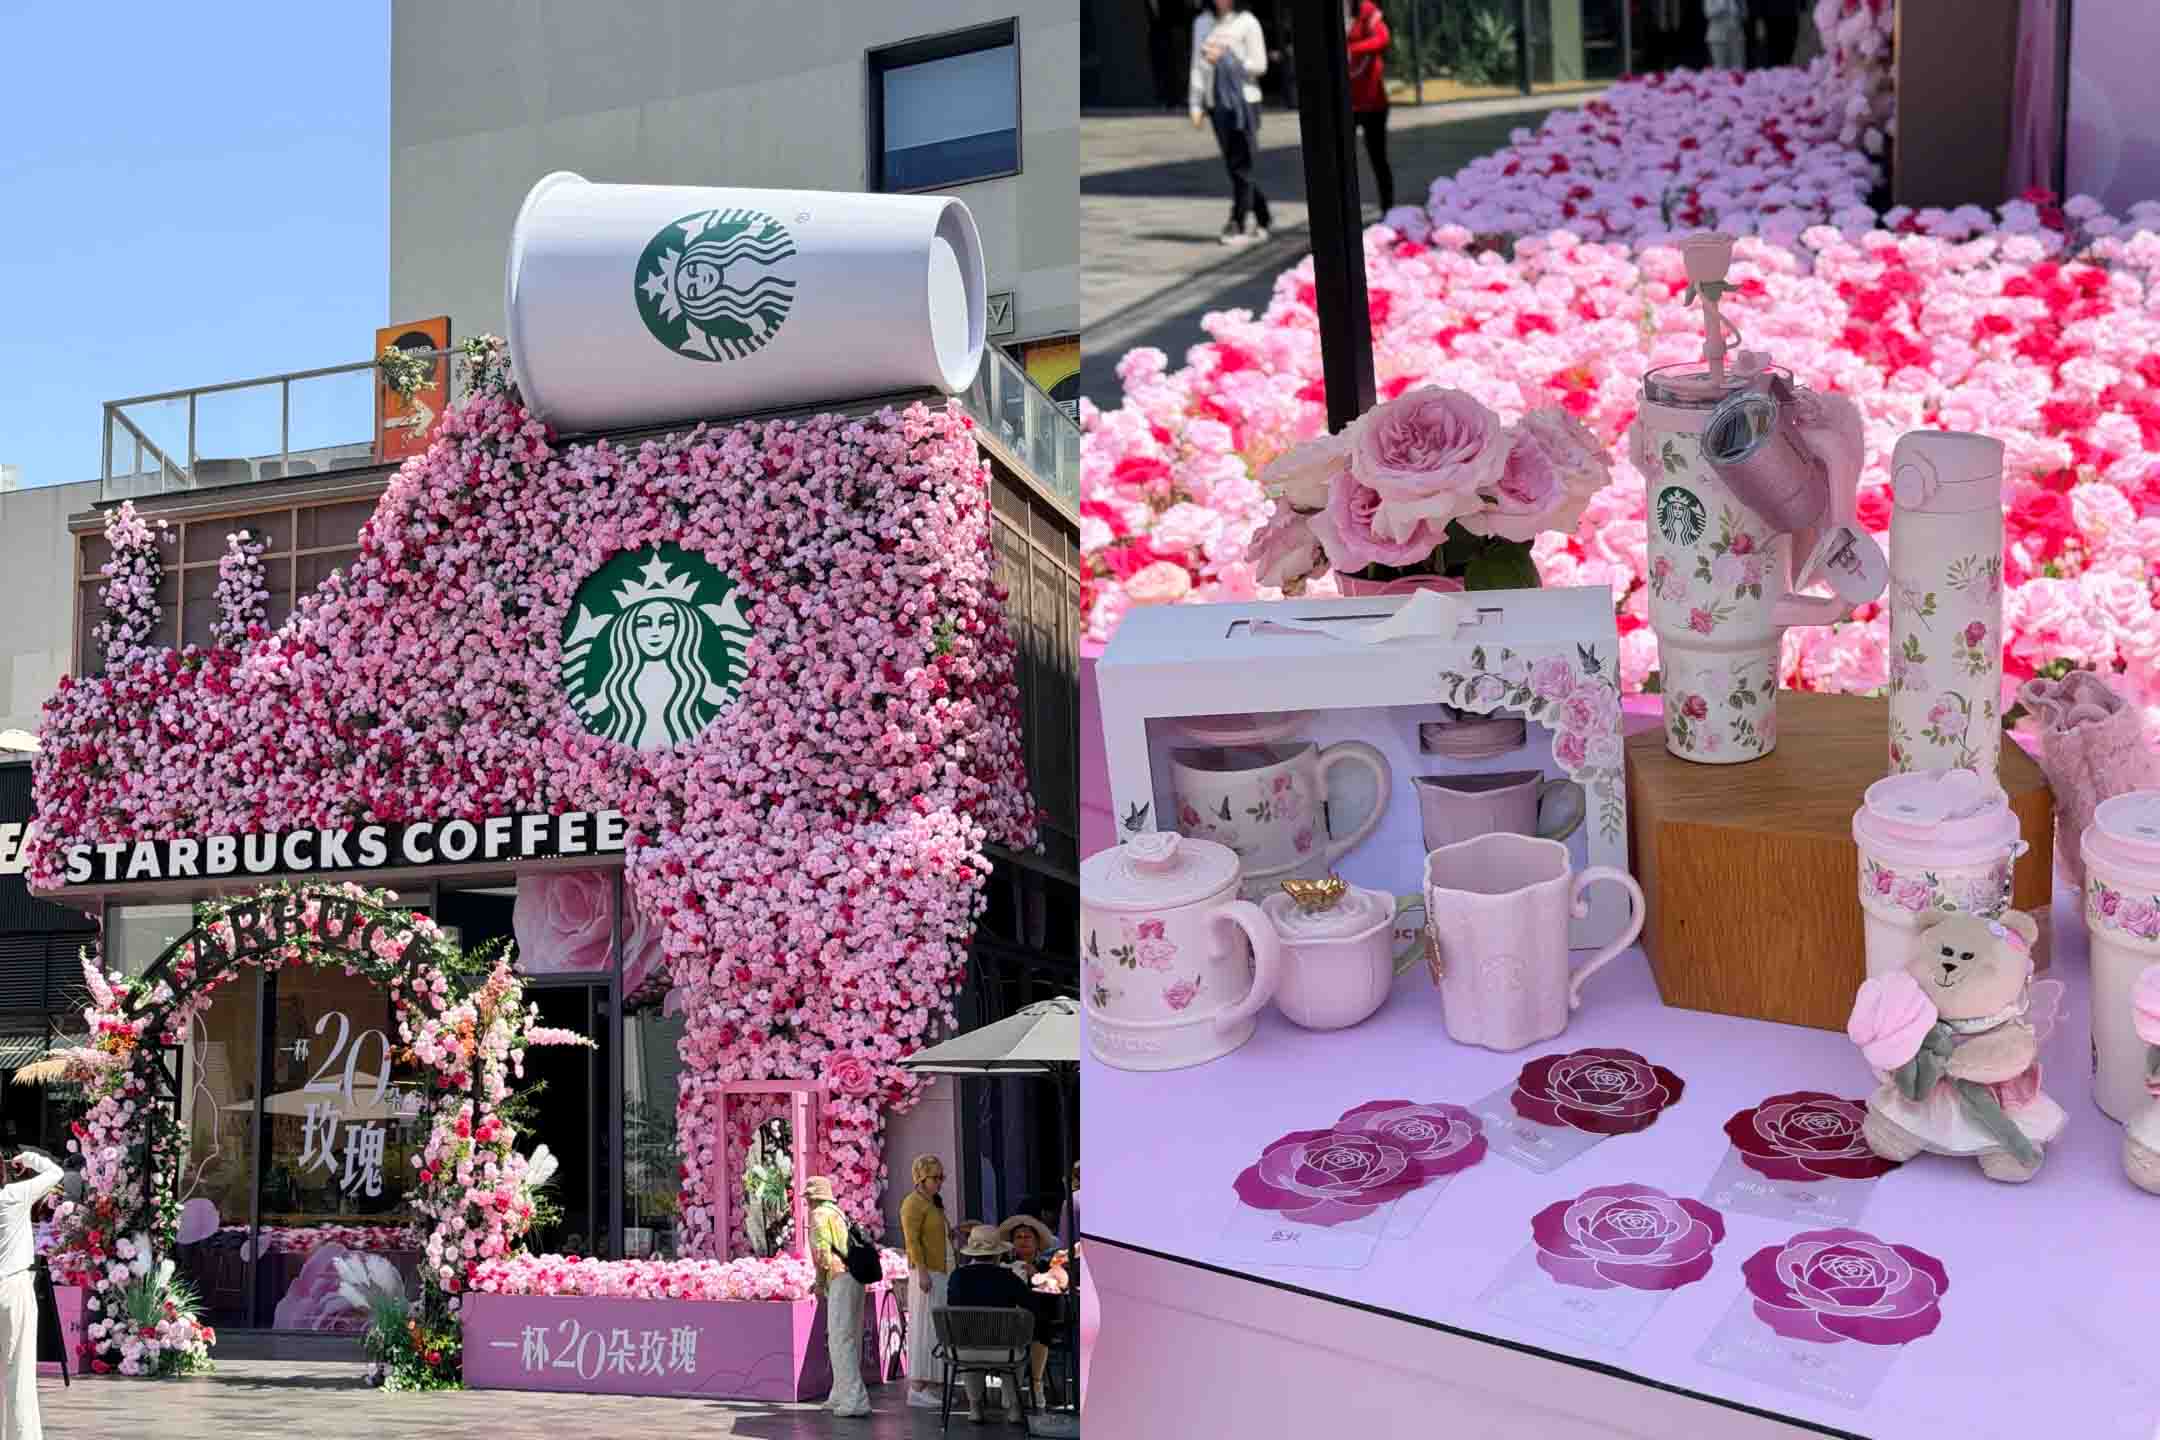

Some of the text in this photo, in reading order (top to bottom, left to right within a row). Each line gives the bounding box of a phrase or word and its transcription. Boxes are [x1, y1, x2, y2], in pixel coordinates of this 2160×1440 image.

[65, 809, 625, 884] STARBUCKS COFFEE
[298, 1101, 386, 1197] 玫瑰
[489, 1319, 698, 1380] 一杯20朵玫瑰
